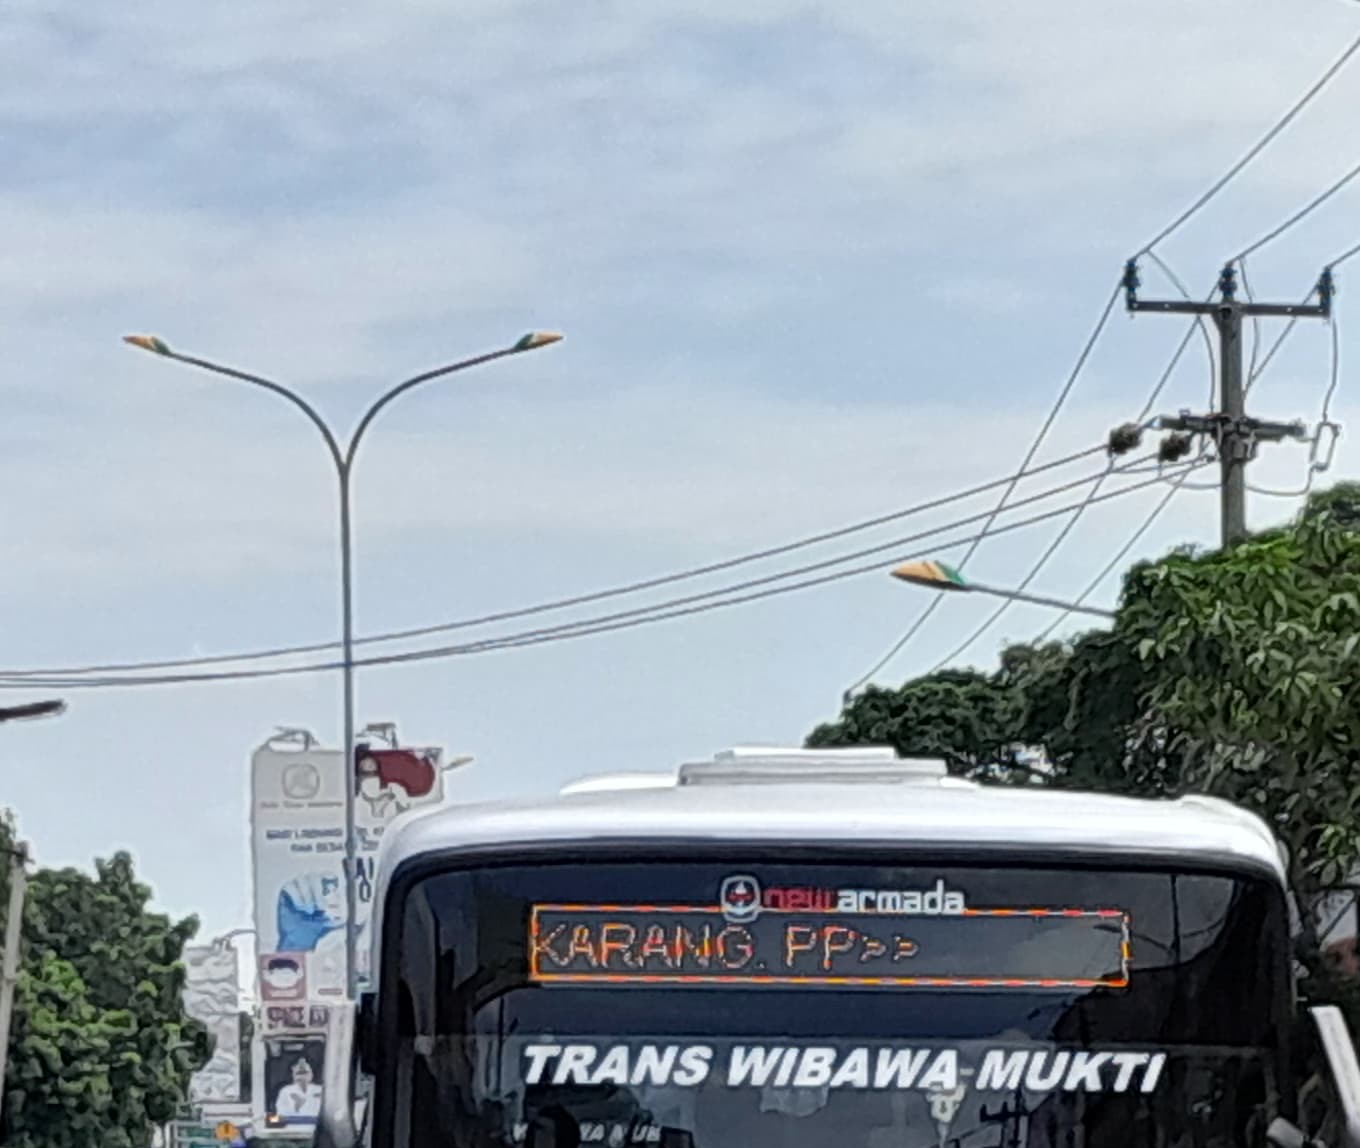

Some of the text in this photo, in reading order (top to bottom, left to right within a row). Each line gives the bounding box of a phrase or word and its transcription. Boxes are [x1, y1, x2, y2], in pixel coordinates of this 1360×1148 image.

[522, 1045, 1168, 1093] TRANS WIBAWA MUKTI
